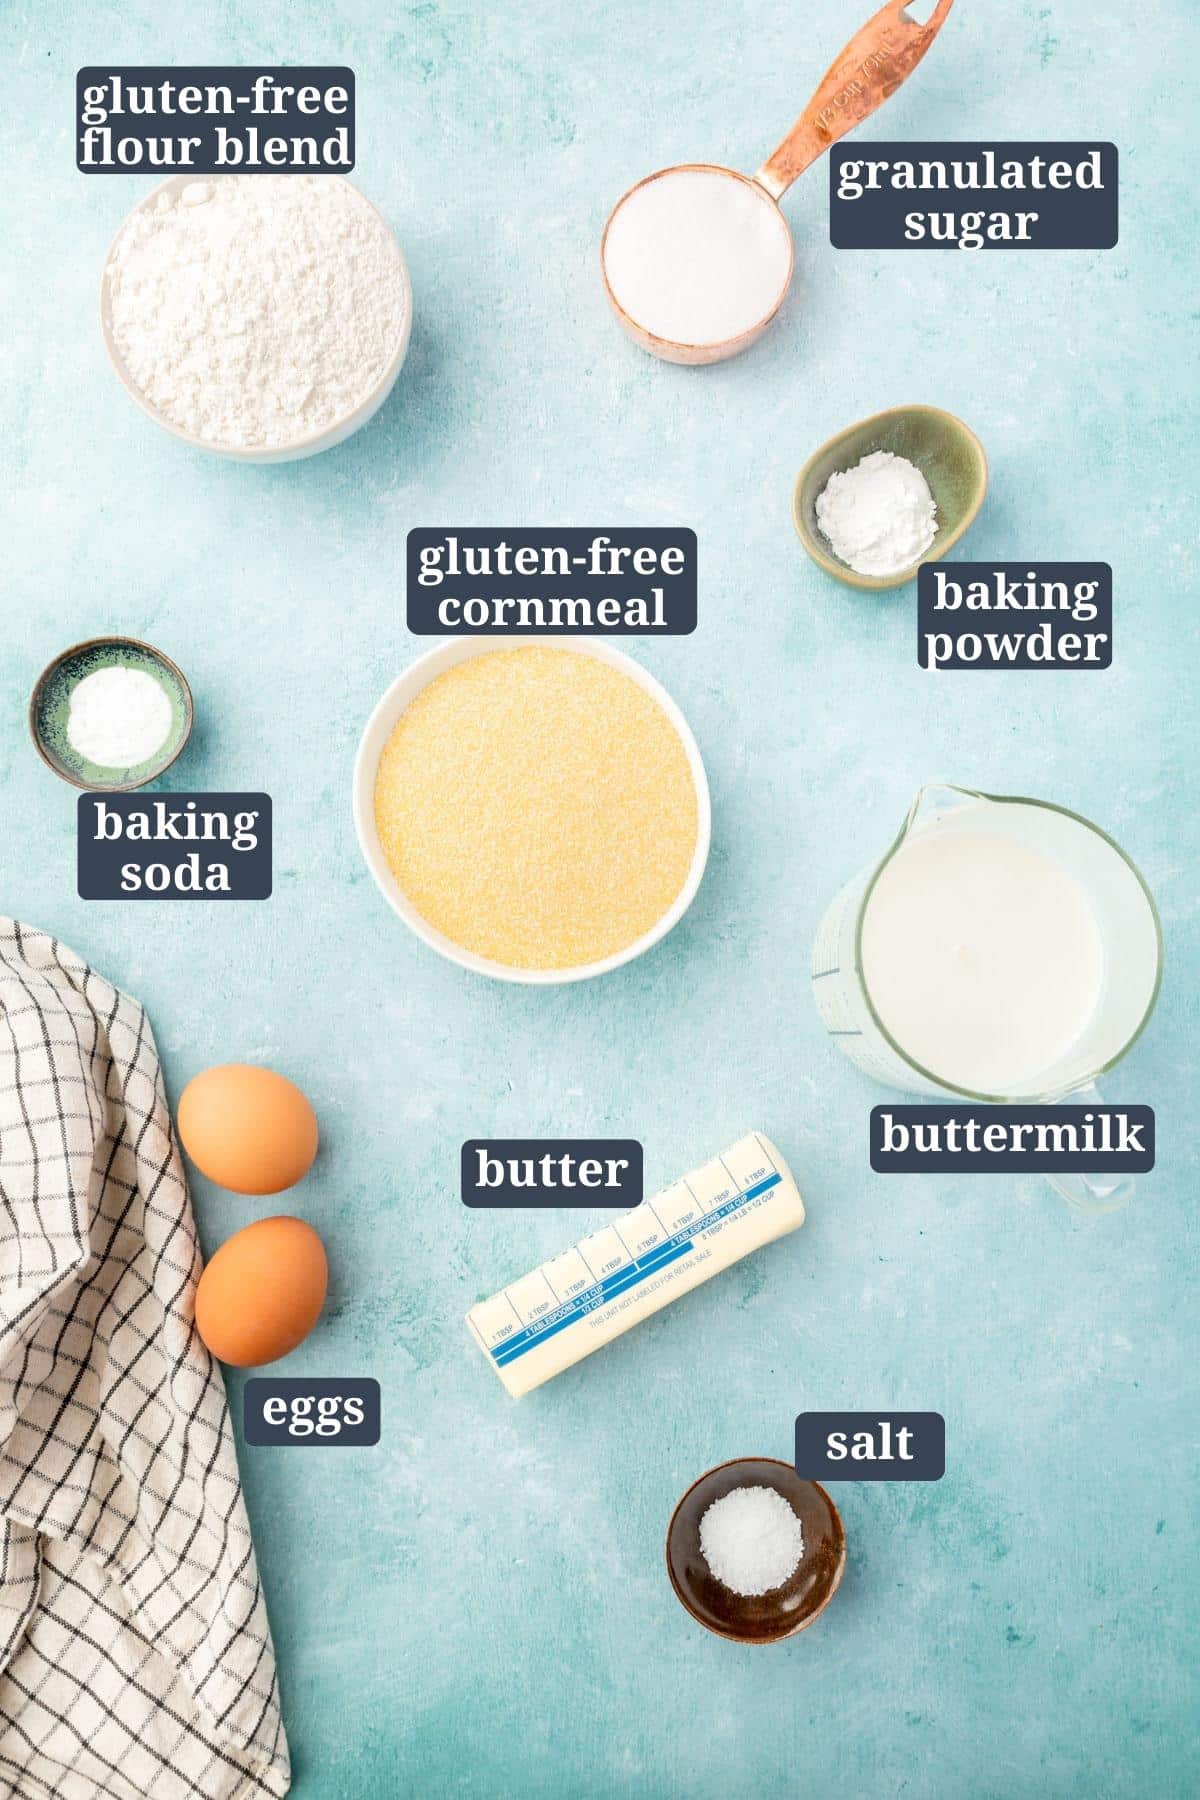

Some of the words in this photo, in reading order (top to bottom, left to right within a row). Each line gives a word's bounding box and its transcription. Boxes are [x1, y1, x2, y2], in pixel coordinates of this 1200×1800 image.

[674, 1212, 720, 1243] TABLESPOONS
[733, 1194, 749, 1207] CUP
[529, 1301, 576, 1334] TABLESPOONS
[588, 1284, 604, 1297] CUP
[589, 1295, 605, 1308] CUP
